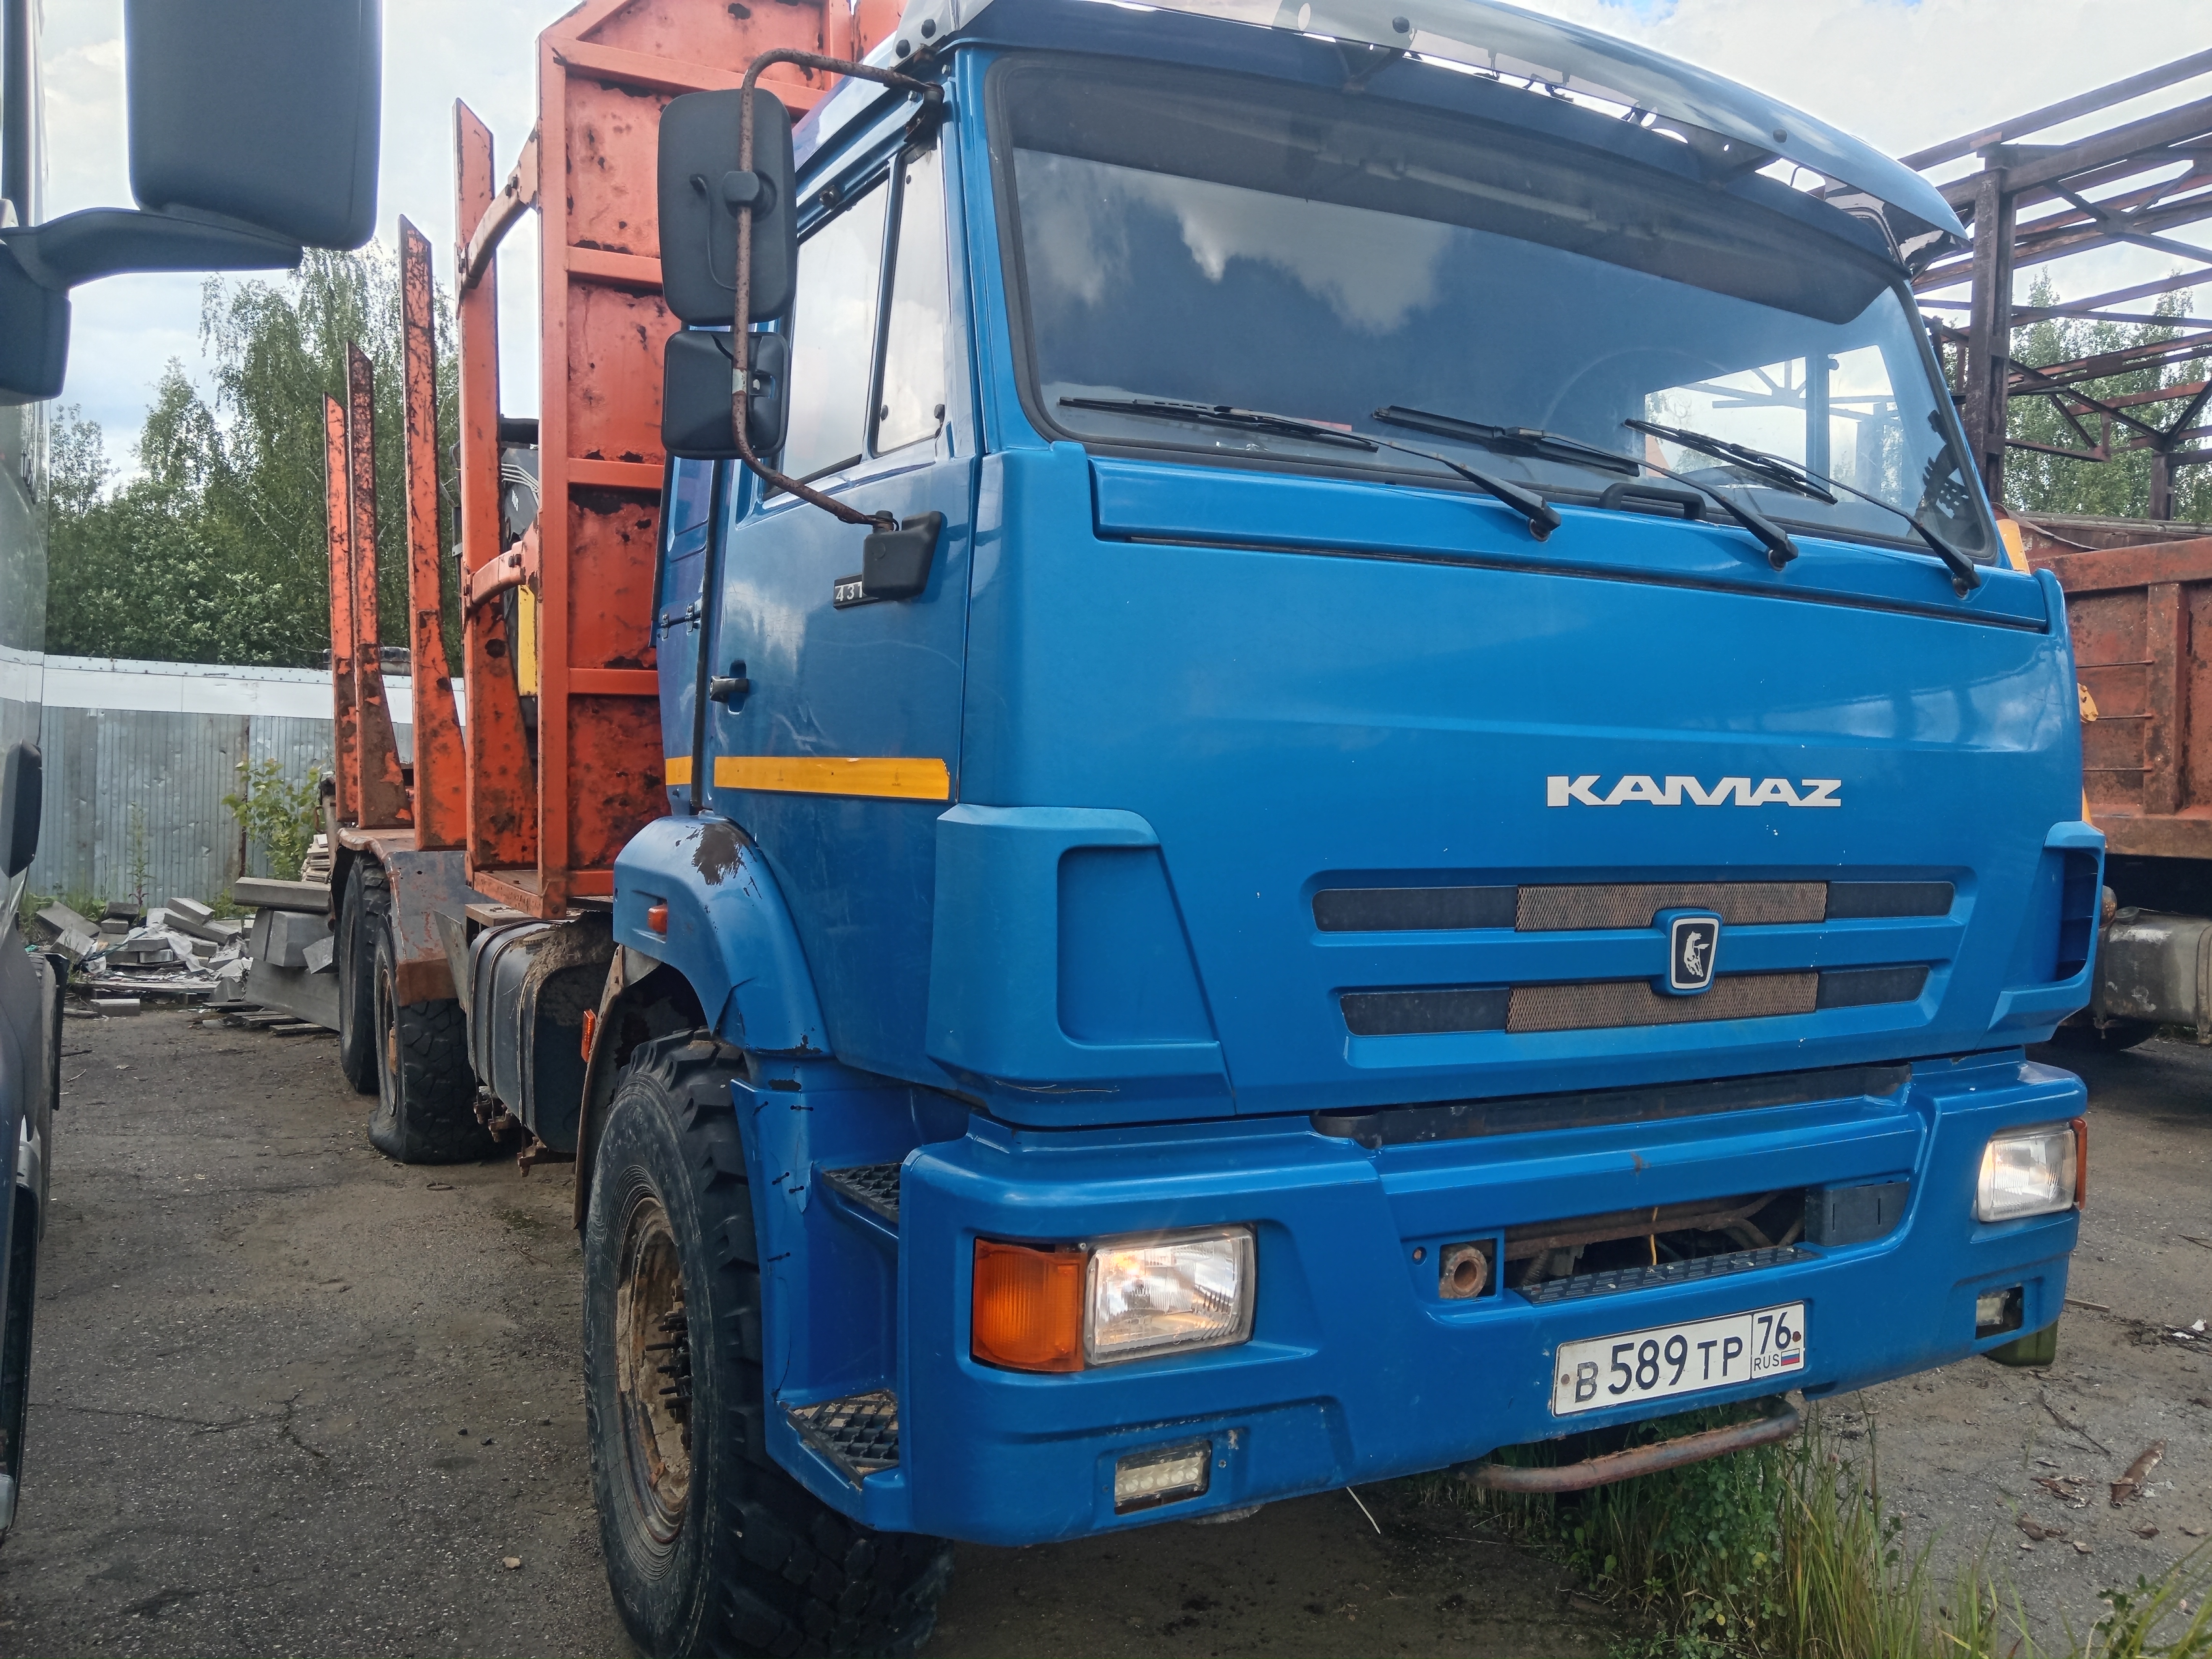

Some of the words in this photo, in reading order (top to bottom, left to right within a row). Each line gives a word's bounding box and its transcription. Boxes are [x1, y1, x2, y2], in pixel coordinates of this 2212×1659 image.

[1547, 775, 1842, 807] KAMAZ
[1757, 1311, 1791, 1355] 76
[1753, 1353, 1780, 1372] RUS
